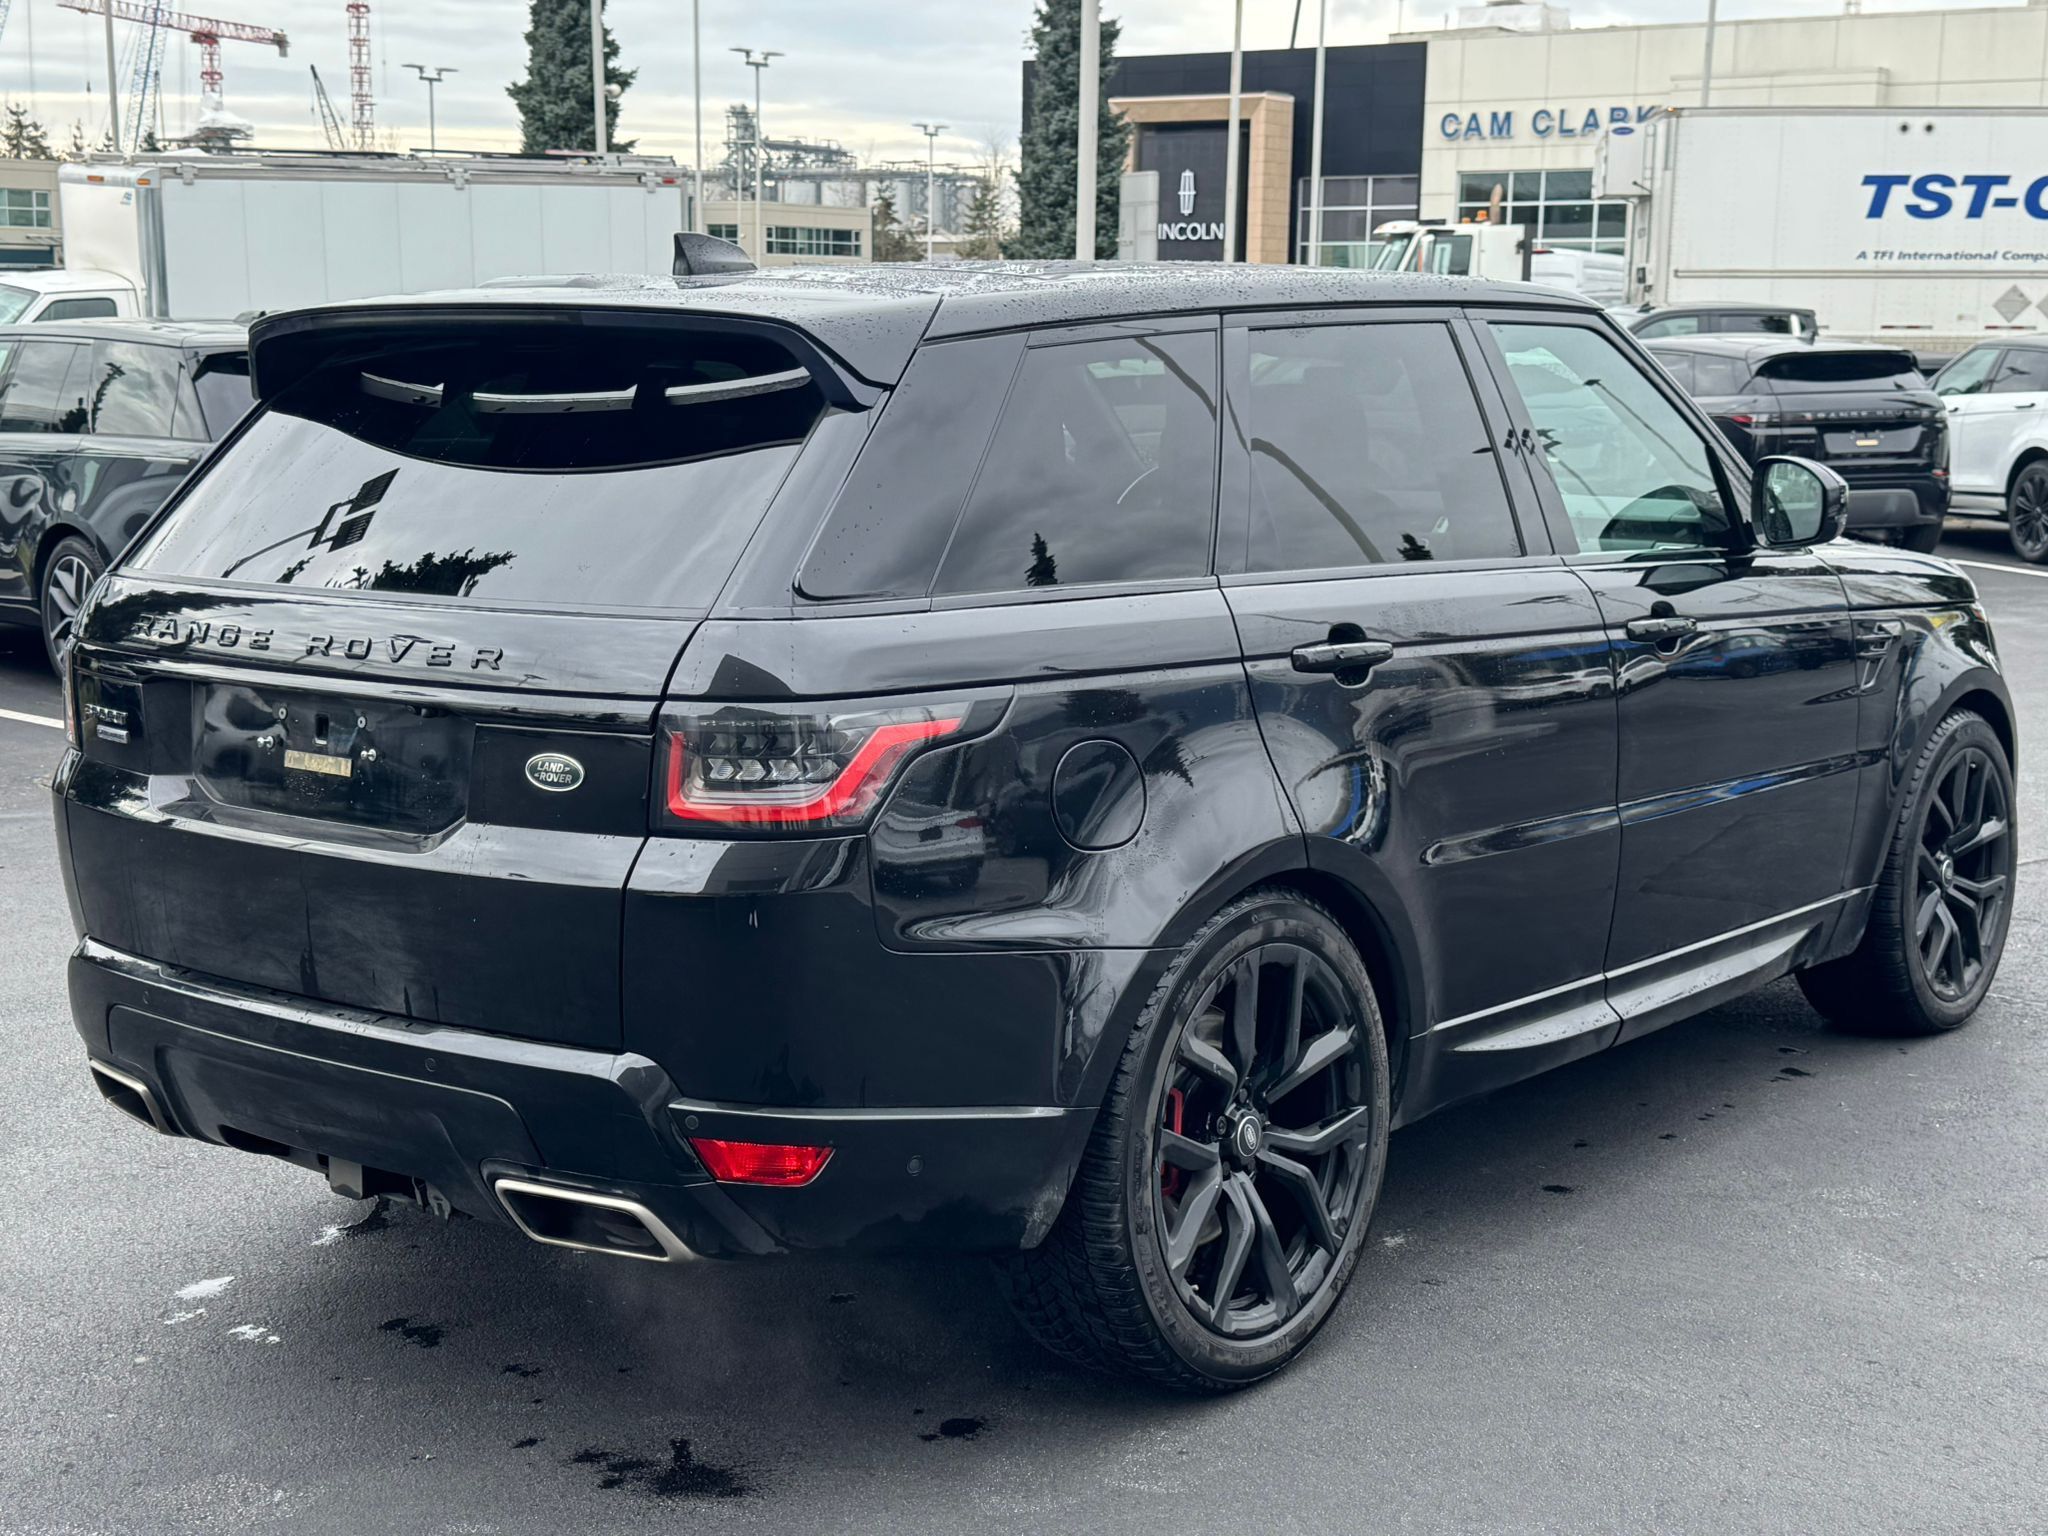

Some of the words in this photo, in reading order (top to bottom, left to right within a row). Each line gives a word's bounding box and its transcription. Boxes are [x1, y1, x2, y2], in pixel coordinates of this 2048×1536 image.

[1440, 111, 1514, 139] CAM
[1158, 222, 1225, 240] INCOLN
[1856, 251, 1867, 260] A
[1873, 251, 1894, 260] TFI
[1898, 250, 1998, 261] International
[131, 613, 276, 651] RANGE
[304, 632, 504, 671] ROVER
[537, 761, 564, 773] LAND
[539, 772, 573, 784] ROVER
